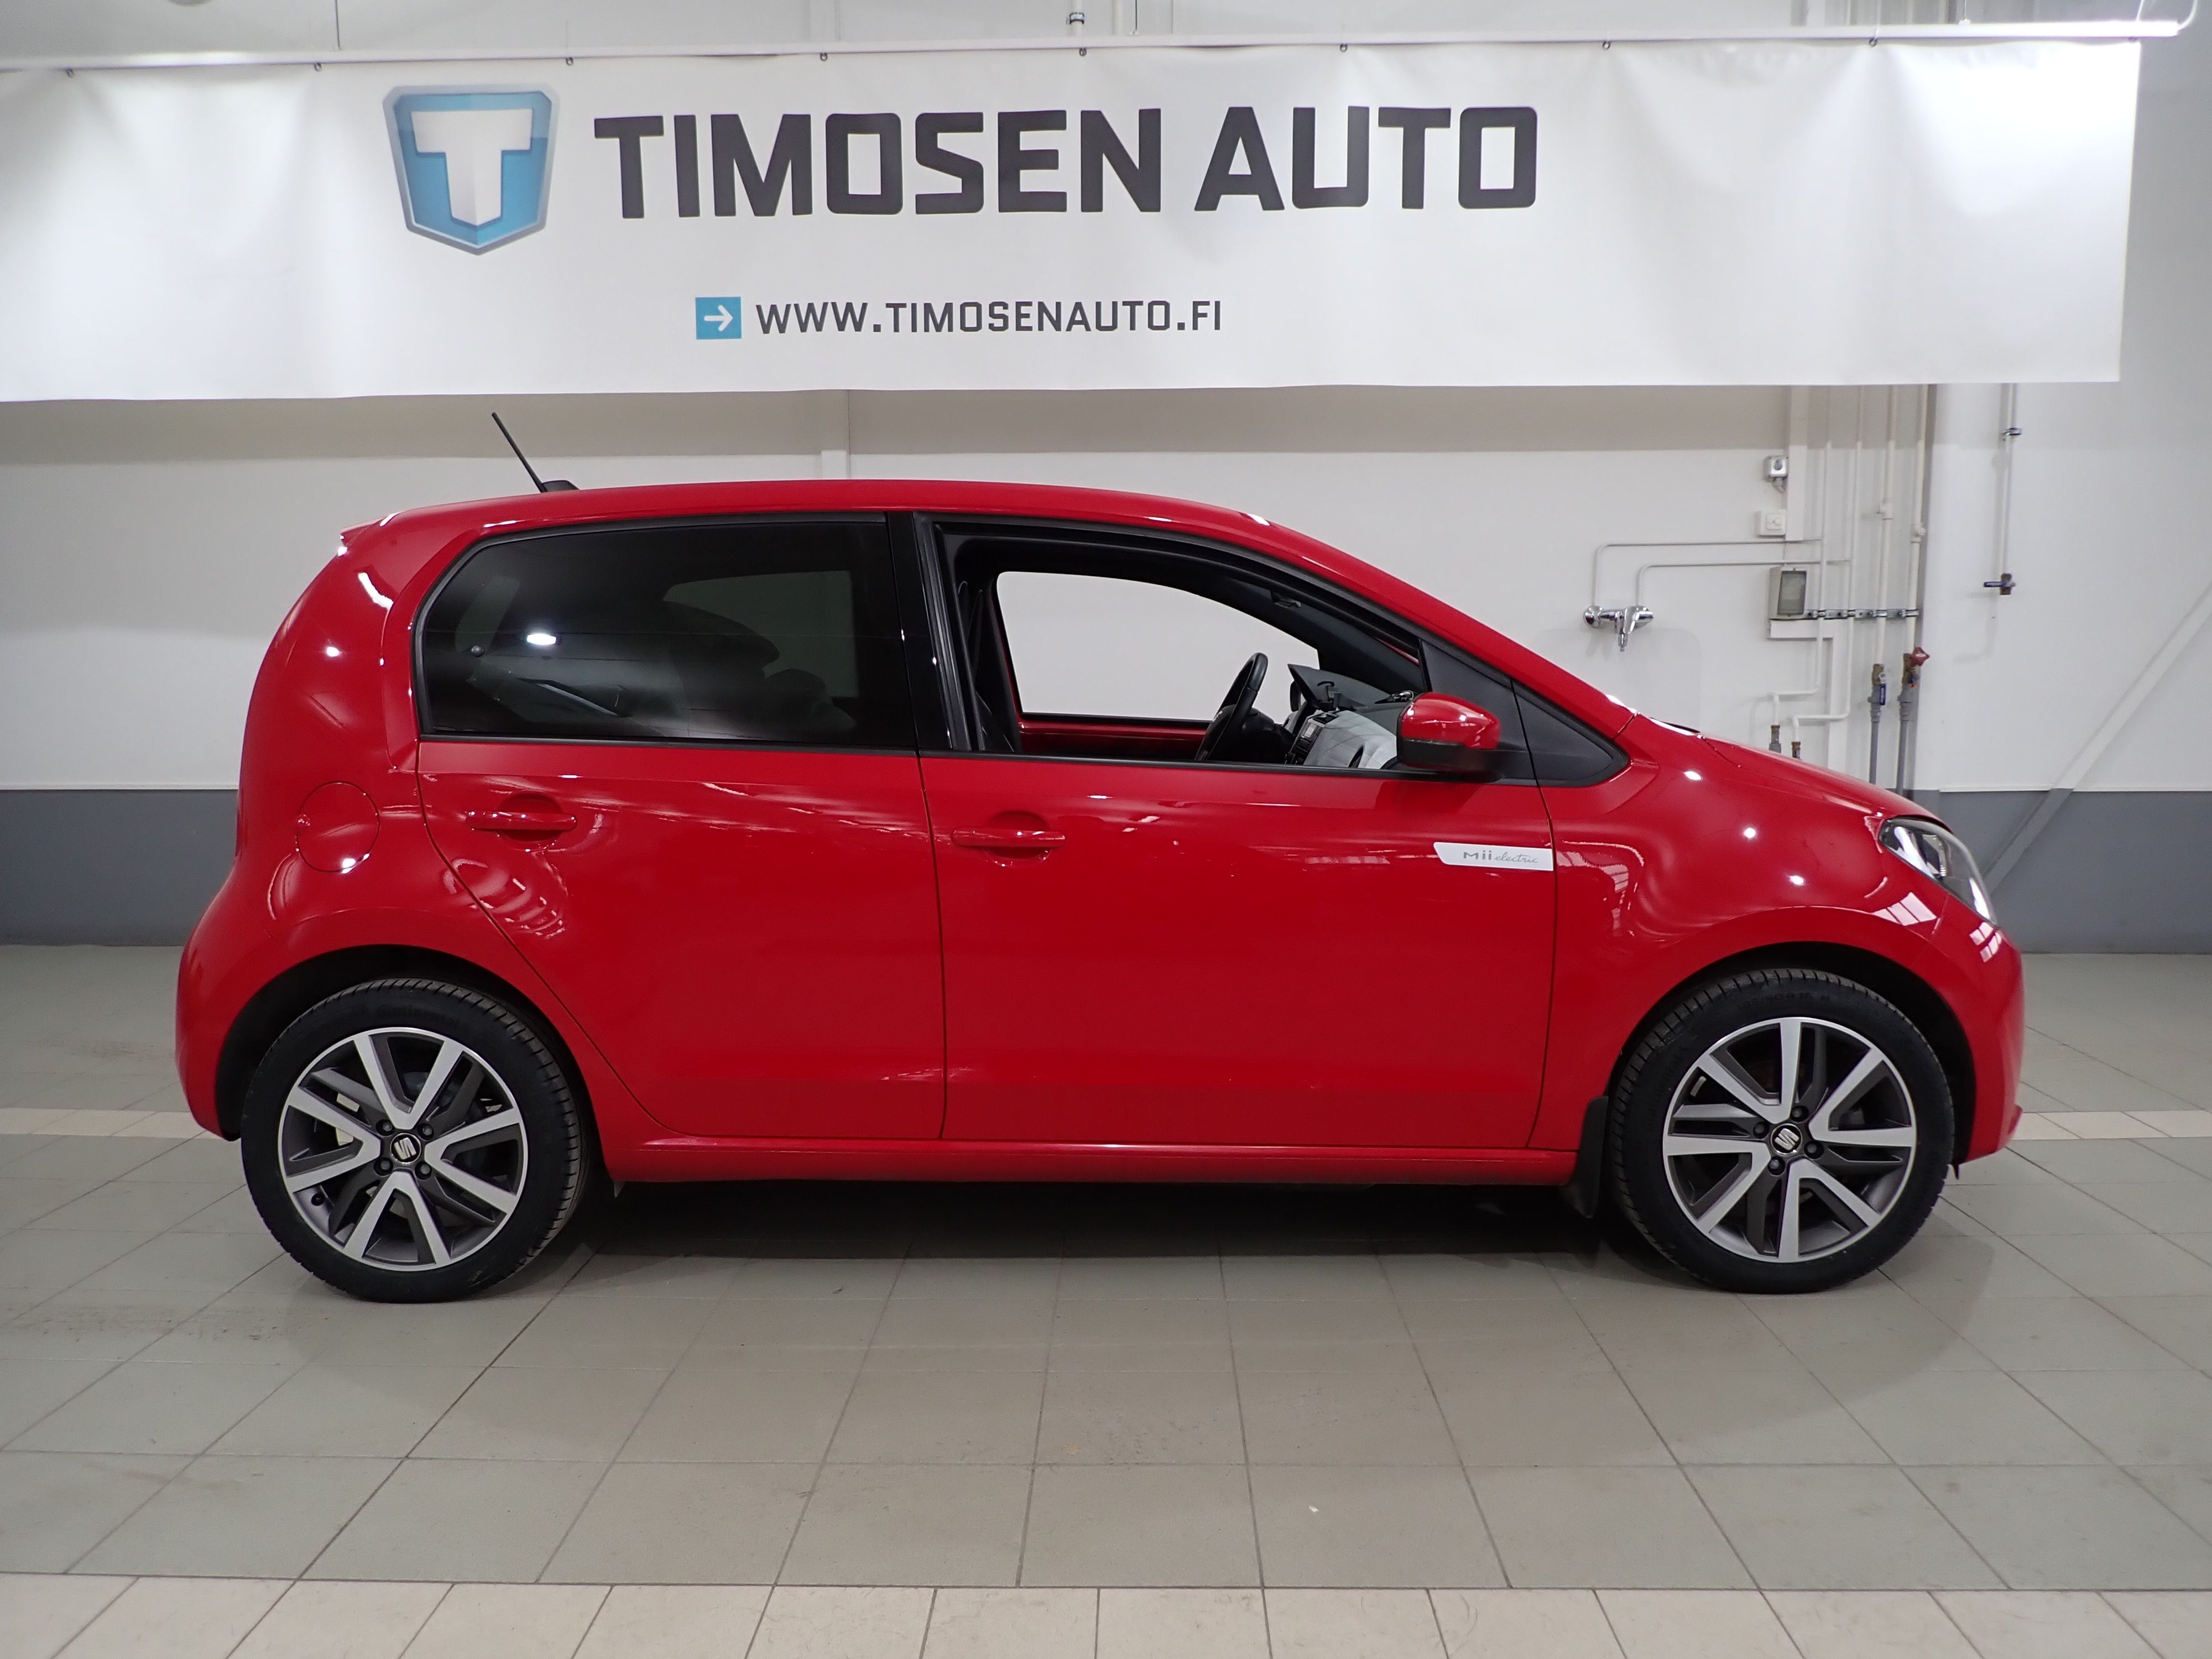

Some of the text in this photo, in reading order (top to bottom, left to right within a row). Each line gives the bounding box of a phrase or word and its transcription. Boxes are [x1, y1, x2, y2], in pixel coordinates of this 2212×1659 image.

[593, 106, 1538, 219] TIMOSEN AUTO
[755, 300, 1220, 334] WWW.TIMOSENAUTO.FI
[1463, 850, 1539, 863] Mii electric
